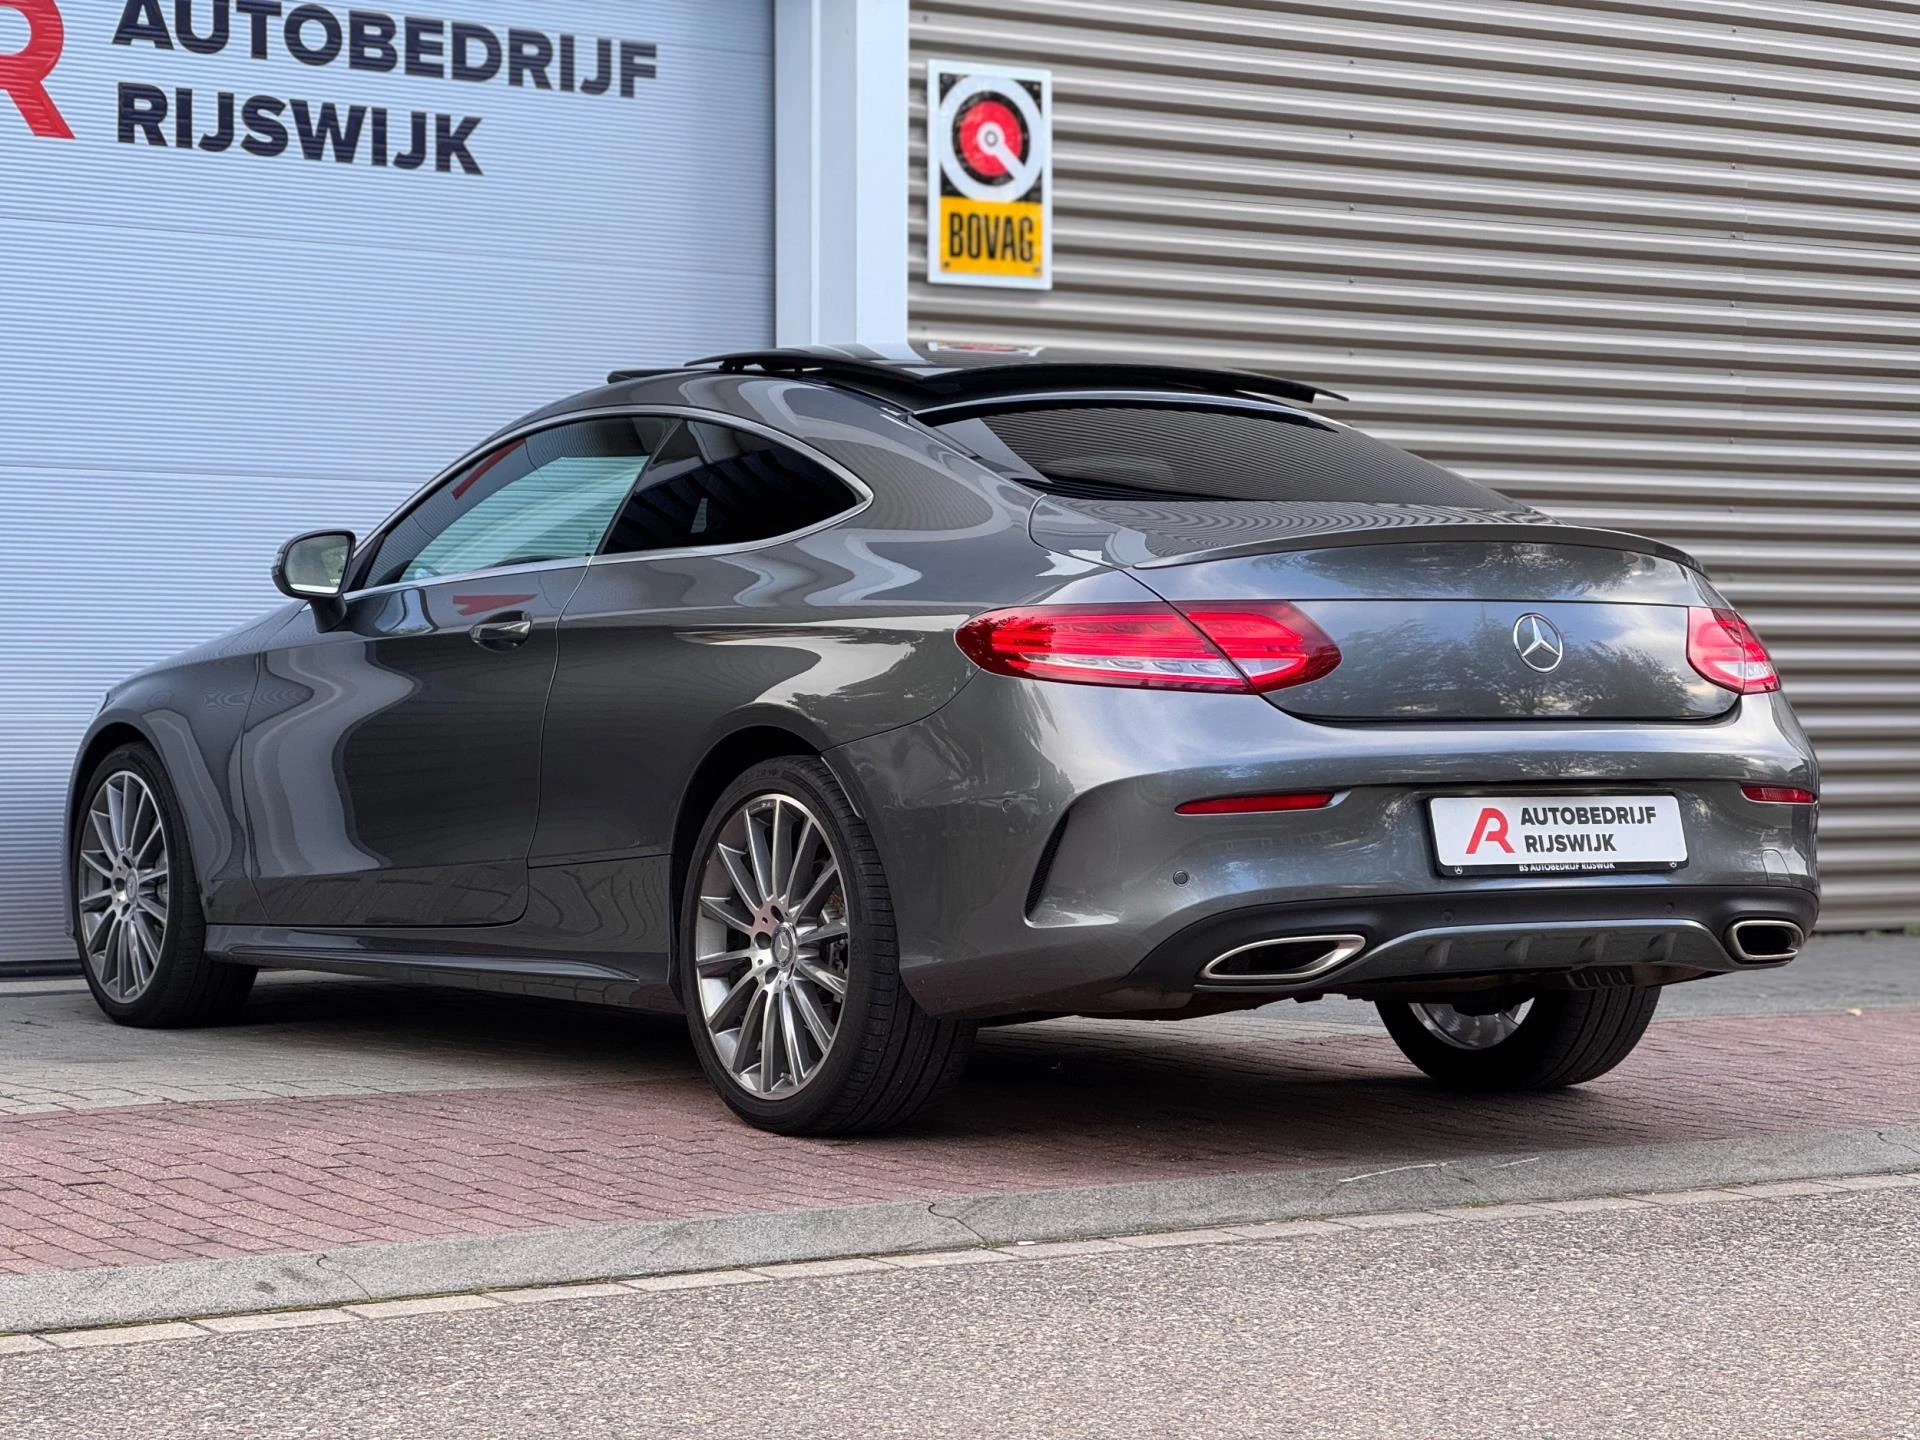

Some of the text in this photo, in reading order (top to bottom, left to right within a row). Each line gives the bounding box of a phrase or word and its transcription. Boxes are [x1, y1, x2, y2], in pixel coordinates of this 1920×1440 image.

[112, 0, 657, 99] AUTOBEDRIJF
[117, 82, 484, 176] RIJSWIJK
[949, 212, 1034, 263] BOVAG
[1520, 806, 1656, 826] AUTOBEDRIJF
[1524, 833, 1617, 853] RIJSWIJK
[1530, 863, 1580, 872] AUTOBEDRIJF
